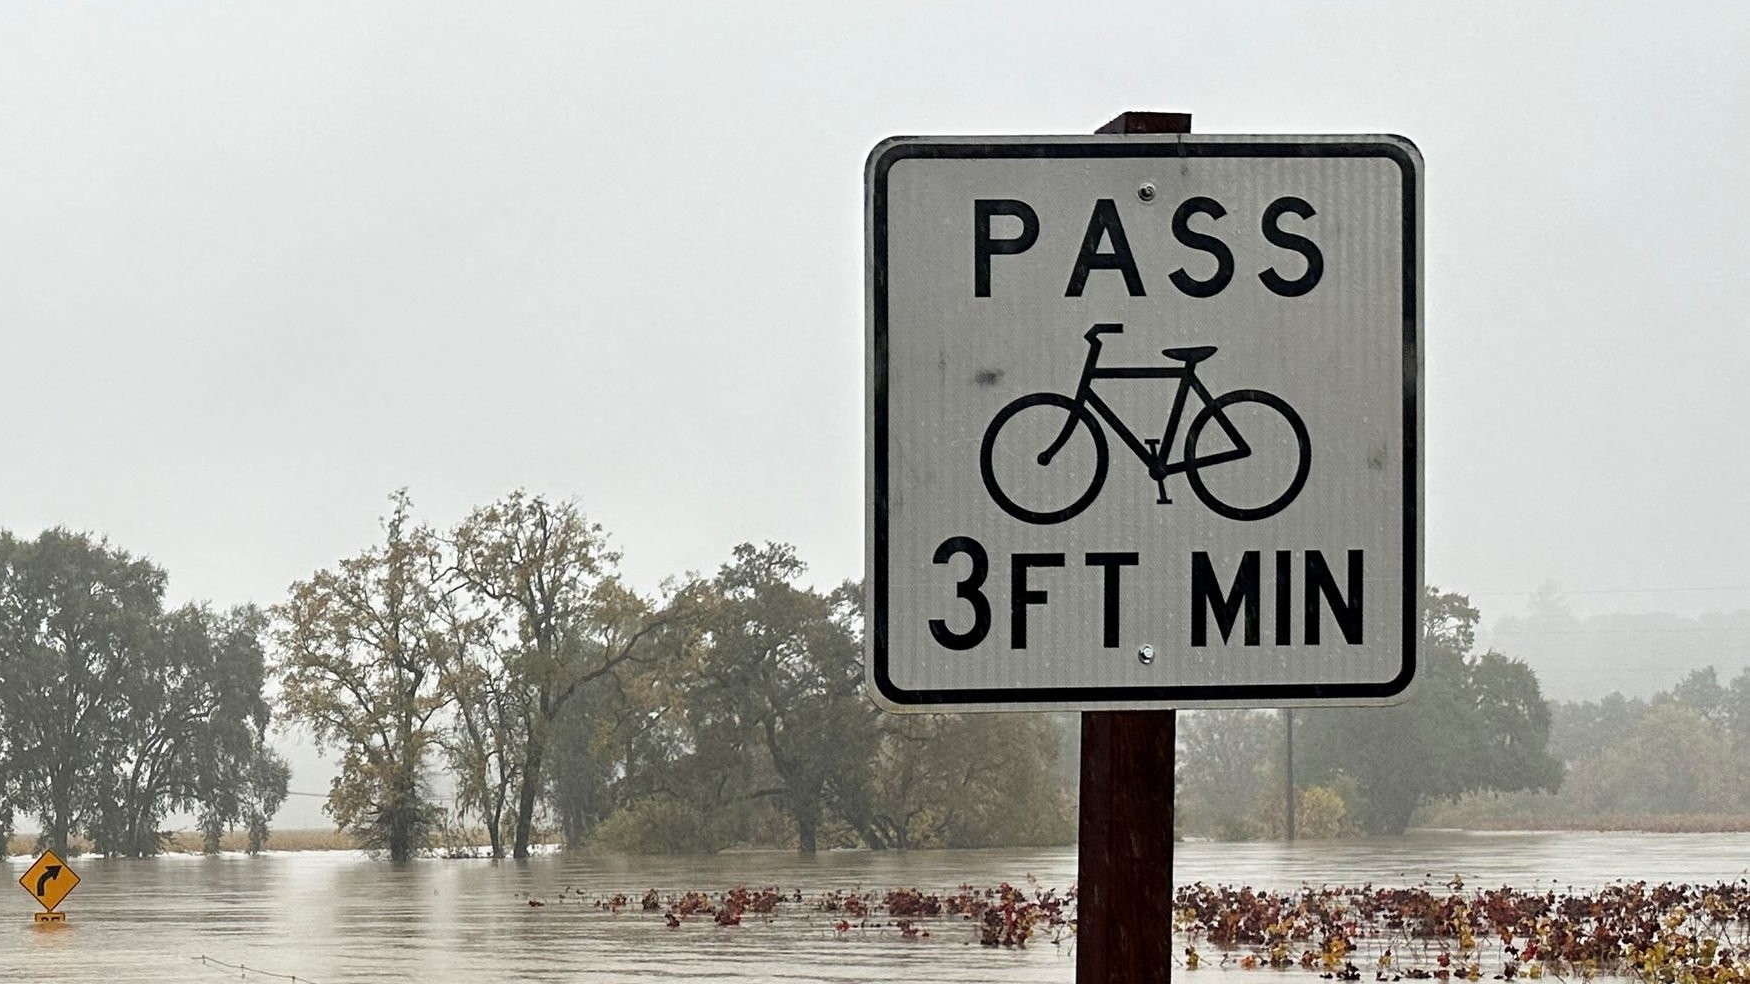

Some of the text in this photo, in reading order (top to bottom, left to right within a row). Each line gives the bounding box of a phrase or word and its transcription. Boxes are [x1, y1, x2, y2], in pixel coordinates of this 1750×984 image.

[973, 196, 1325, 299] PASS
[928, 535, 1364, 651] 3FT MIN
